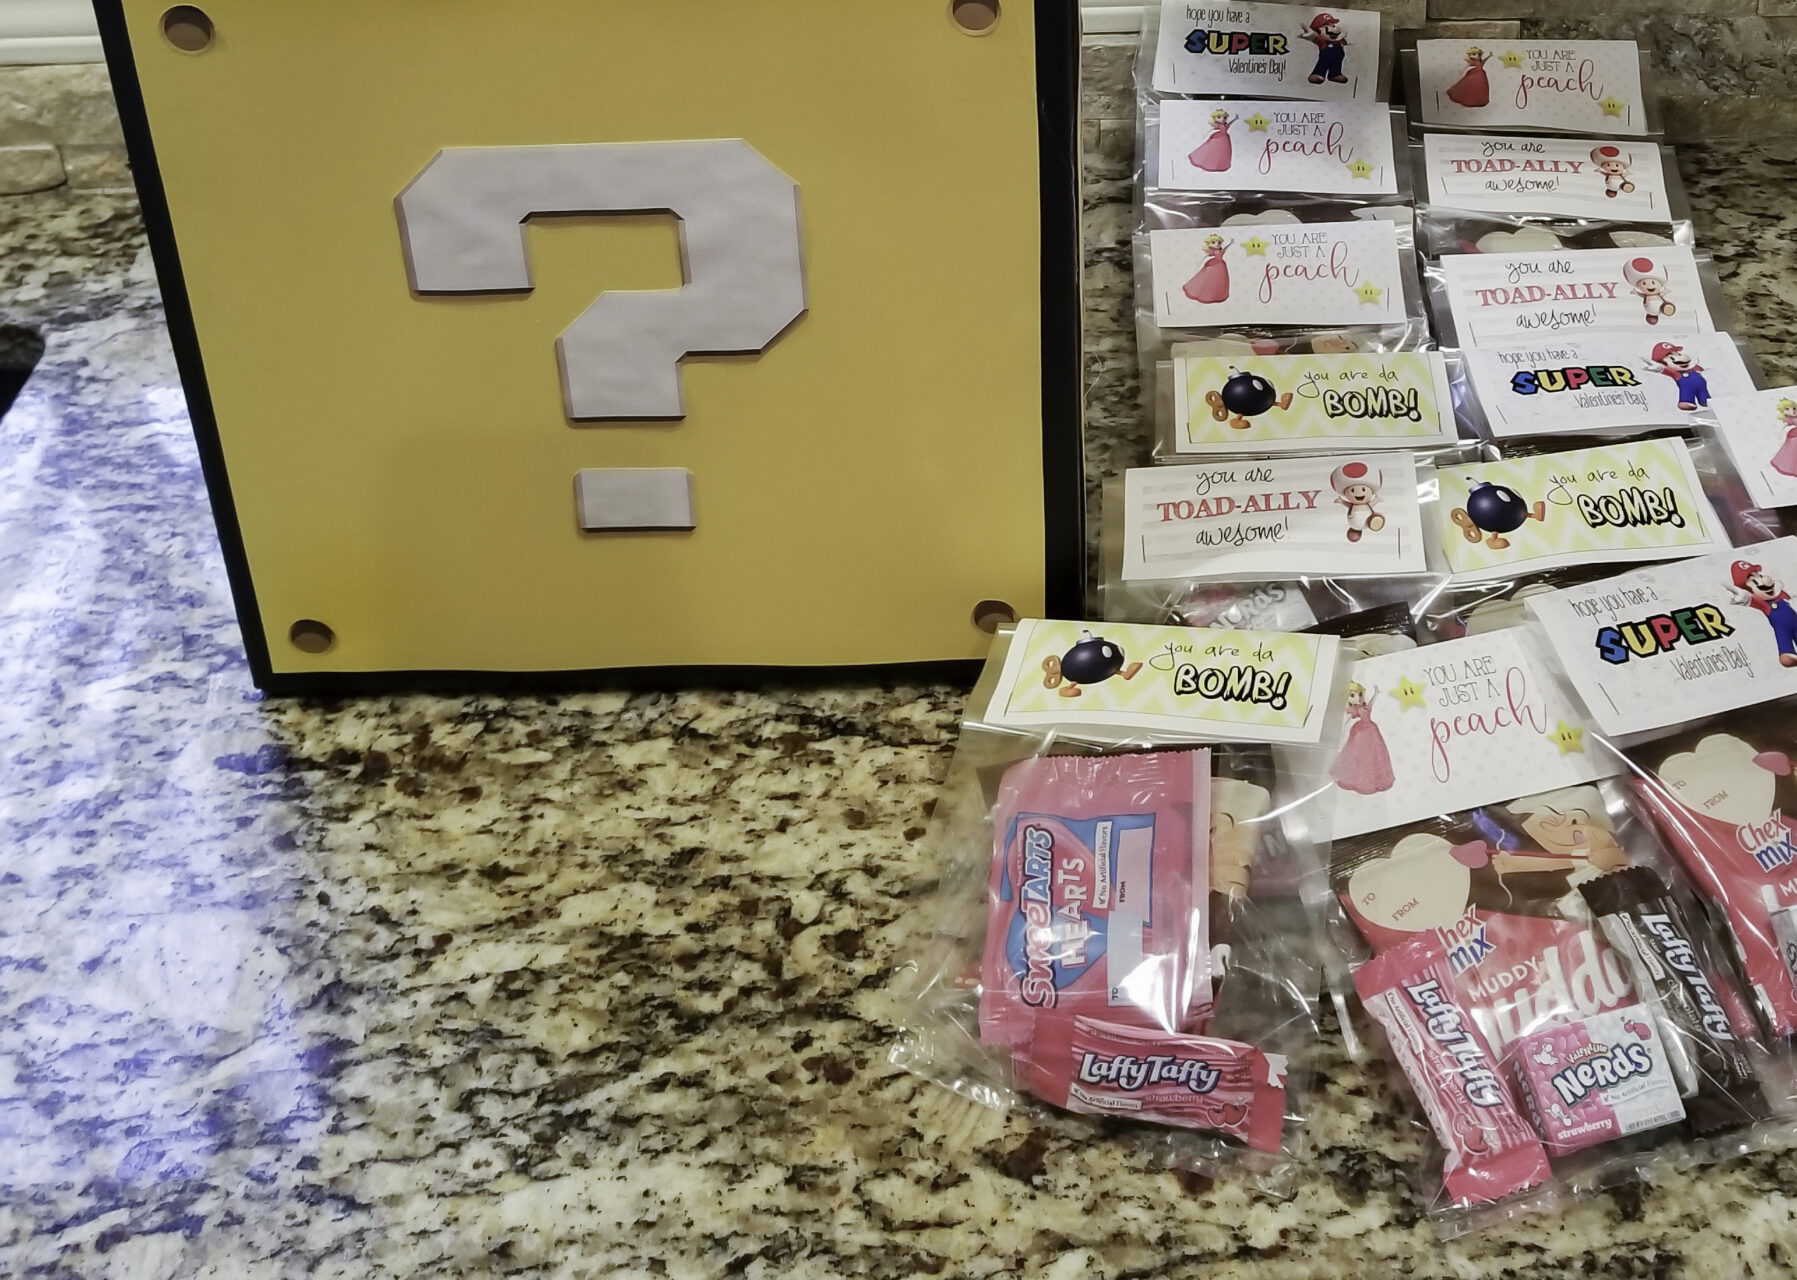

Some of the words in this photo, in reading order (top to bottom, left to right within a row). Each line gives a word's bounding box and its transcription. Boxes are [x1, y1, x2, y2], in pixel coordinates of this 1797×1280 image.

[1186, 4, 1206, 27] hope
[1208, 8, 1224, 28] you
[1226, 7, 1243, 23] have
[1245, 11, 1251, 24] a
[1184, 29, 1290, 55] SUPER
[1526, 49, 1550, 61] YOU
[1552, 49, 1576, 61] ARE
[1269, 59, 1287, 81] Day!
[1531, 61, 1560, 72] JUST
[1566, 61, 1574, 73] A
[1515, 59, 1604, 110] peach
[1273, 112, 1296, 124] YOU
[1301, 112, 1325, 124] ARE
[1277, 124, 1309, 136] JUST
[1313, 125, 1323, 136] A
[1258, 122, 1353, 175] peach
[1481, 140, 1515, 157] you
[1521, 143, 1546, 154] are
[1451, 158, 1585, 174] TOAD-ALLY
[1485, 176, 1560, 194] awesome!
[1272, 233, 1296, 245] YOU
[1301, 232, 1328, 244] ARE
[1277, 246, 1309, 258] JUST
[1315, 246, 1326, 258] A
[1258, 241, 1360, 303] peach
[1505, 260, 1542, 284] you
[1548, 259, 1575, 274] are
[1475, 282, 1618, 306] TOAD-ALLY
[1516, 304, 1597, 330] awesome!
[394, 138, 808, 532] ?
[1499, 351, 1525, 367] hope
[1526, 349, 1545, 368] you
[1547, 347, 1569, 360] have
[1571, 349, 1578, 359] a
[1297, 370, 1330, 399] you
[1339, 371, 1369, 380] are
[1378, 364, 1399, 381] da
[1510, 365, 1642, 396] SUPER
[1323, 386, 1422, 422] BOMB!
[1626, 392, 1649, 411] Day!
[1196, 468, 1236, 495] you
[1244, 467, 1274, 483] are
[1547, 473, 1578, 505] you
[1587, 469, 1617, 482] are
[1628, 459, 1649, 478] da
[1157, 490, 1321, 521] TOAD-ALLY
[1576, 486, 1686, 528] BOMB!
[1196, 516, 1289, 546] awesome!
[1569, 597, 1601, 624] hope
[1600, 593, 1622, 620] you
[1620, 588, 1647, 605] have
[1648, 586, 1658, 600] a
[1595, 603, 1736, 665] SUPER
[1149, 642, 1193, 671] you
[1205, 646, 1240, 657] are
[1253, 642, 1274, 662] da
[1423, 664, 1457, 686] YOU
[1463, 656, 1497, 678] ARE
[1723, 643, 1755, 679] Day!
[1173, 663, 1292, 710] BOMB!
[1439, 682, 1478, 707] JUST
[1487, 678, 1502, 698] A
[1430, 666, 1547, 784] peach
[1673, 780, 1687, 791] TO
[1703, 790, 1729, 810] FROM
[1736, 808, 1792, 854] Chex
[1753, 830, 1797, 873] mix
[1119, 880, 1127, 903] FROM
[1361, 892, 1376, 906] TO
[1056, 858, 1089, 968] HEARTS
[1392, 897, 1420, 922] FROM
[1437, 904, 1484, 949] hex
[1450, 926, 1495, 975] mix
[1467, 955, 1540, 1002] MUDDY
[1557, 1118, 1613, 1141] strawberry
